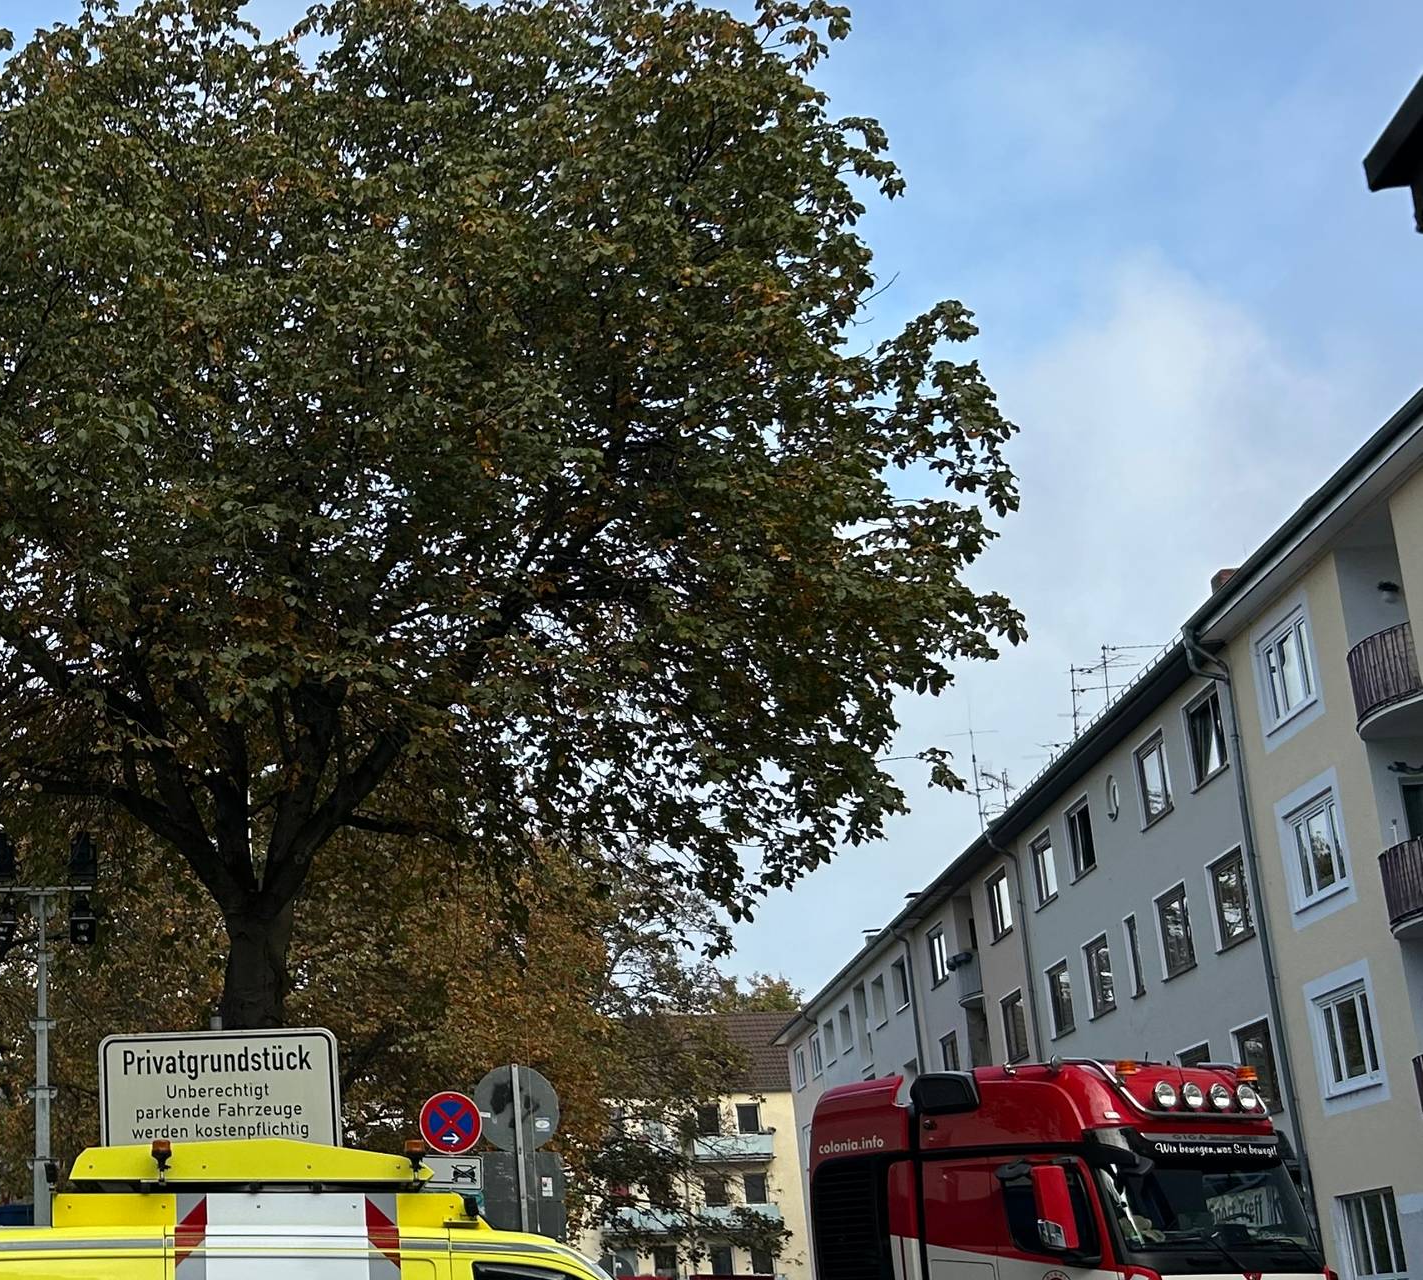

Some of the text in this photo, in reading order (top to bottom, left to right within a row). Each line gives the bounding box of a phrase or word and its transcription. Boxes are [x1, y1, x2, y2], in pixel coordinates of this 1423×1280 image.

[123, 1044, 312, 1080] Privatgrundstück
[166, 1083, 269, 1100] Unberechtigt
[136, 1103, 302, 1122] parkende Fahrzeuge
[132, 1122, 309, 1139] werden kostenpflichtig
[818, 1135, 884, 1154] colonia.info
[1155, 1142, 1177, 1154] Wir
[1234, 1143, 1248, 1155] Sie
[1248, 1144, 1277, 1158] bewegt!
